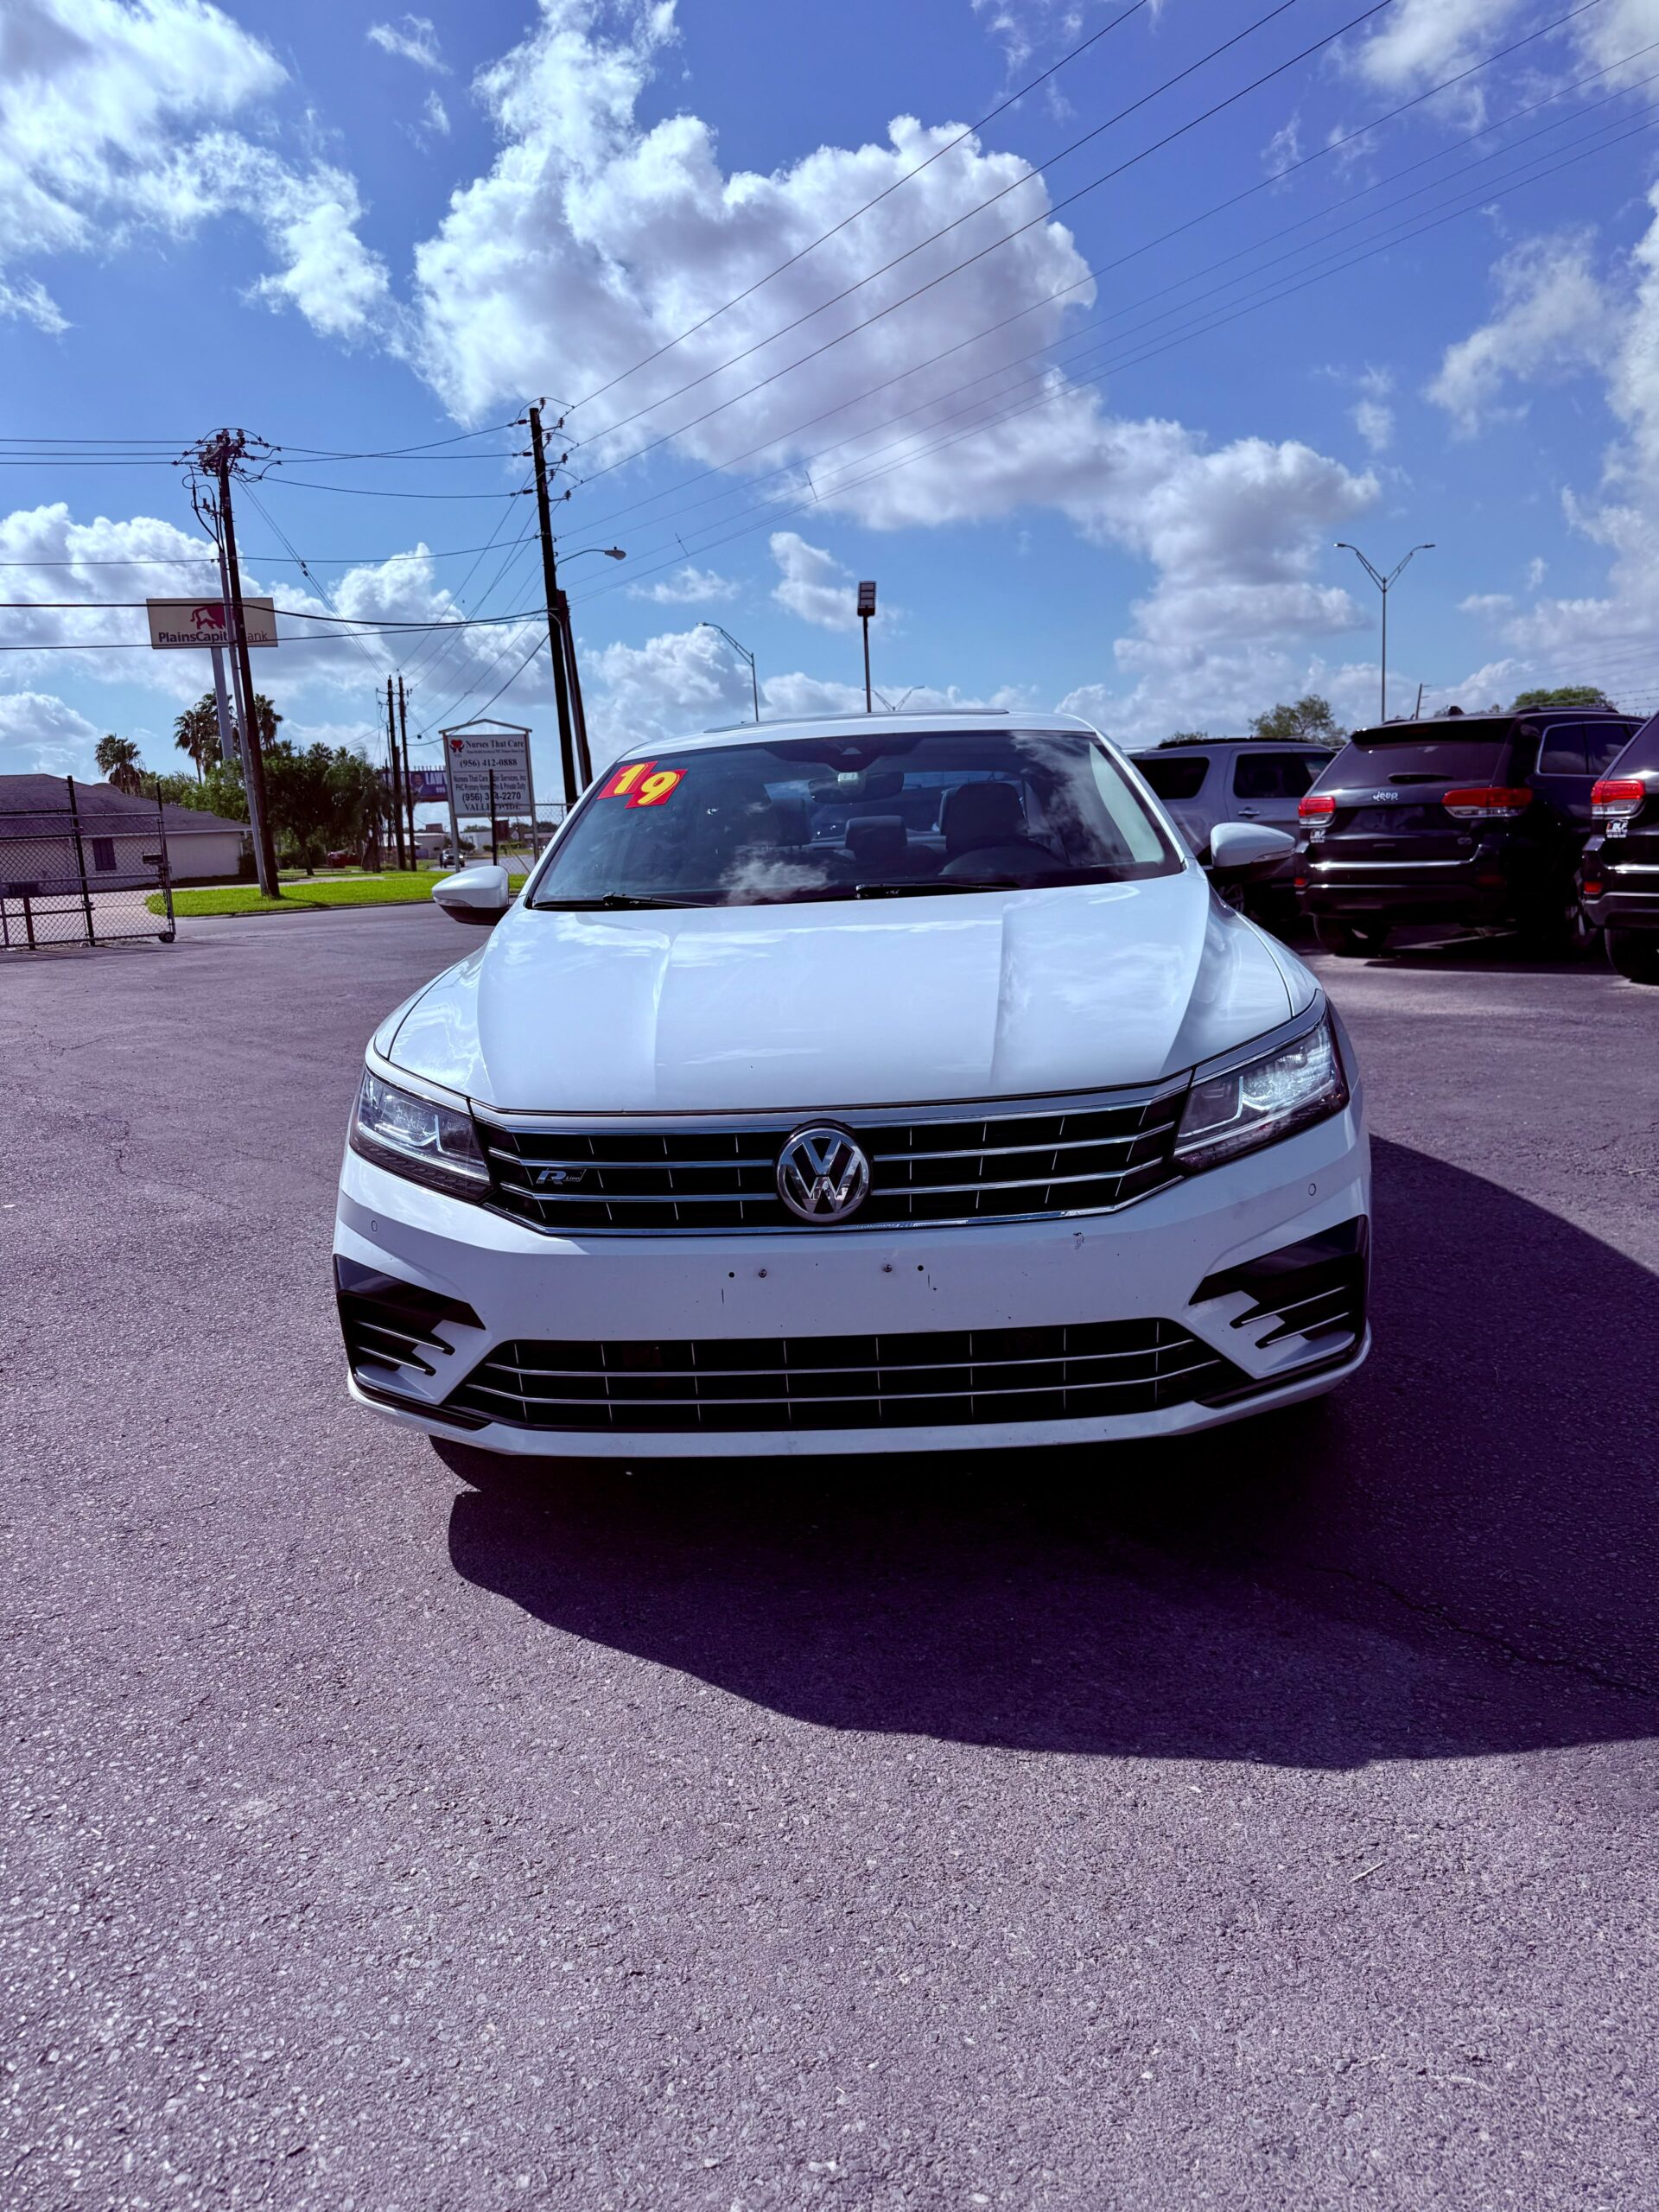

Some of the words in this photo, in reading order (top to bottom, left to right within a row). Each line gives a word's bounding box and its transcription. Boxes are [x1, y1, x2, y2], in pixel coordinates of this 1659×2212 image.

[159, 631, 233, 644] PlainsCapit
[245, 631, 268, 641] ank
[460, 759, 480, 768] (956)
[482, 759, 518, 767] 412-0888
[613, 763, 680, 805] 19
[462, 792, 482, 803] (956)
[485, 791, 521, 801] 34-2270
[1372, 791, 1398, 801] Jeep
[465, 803, 495, 811] VALLE
